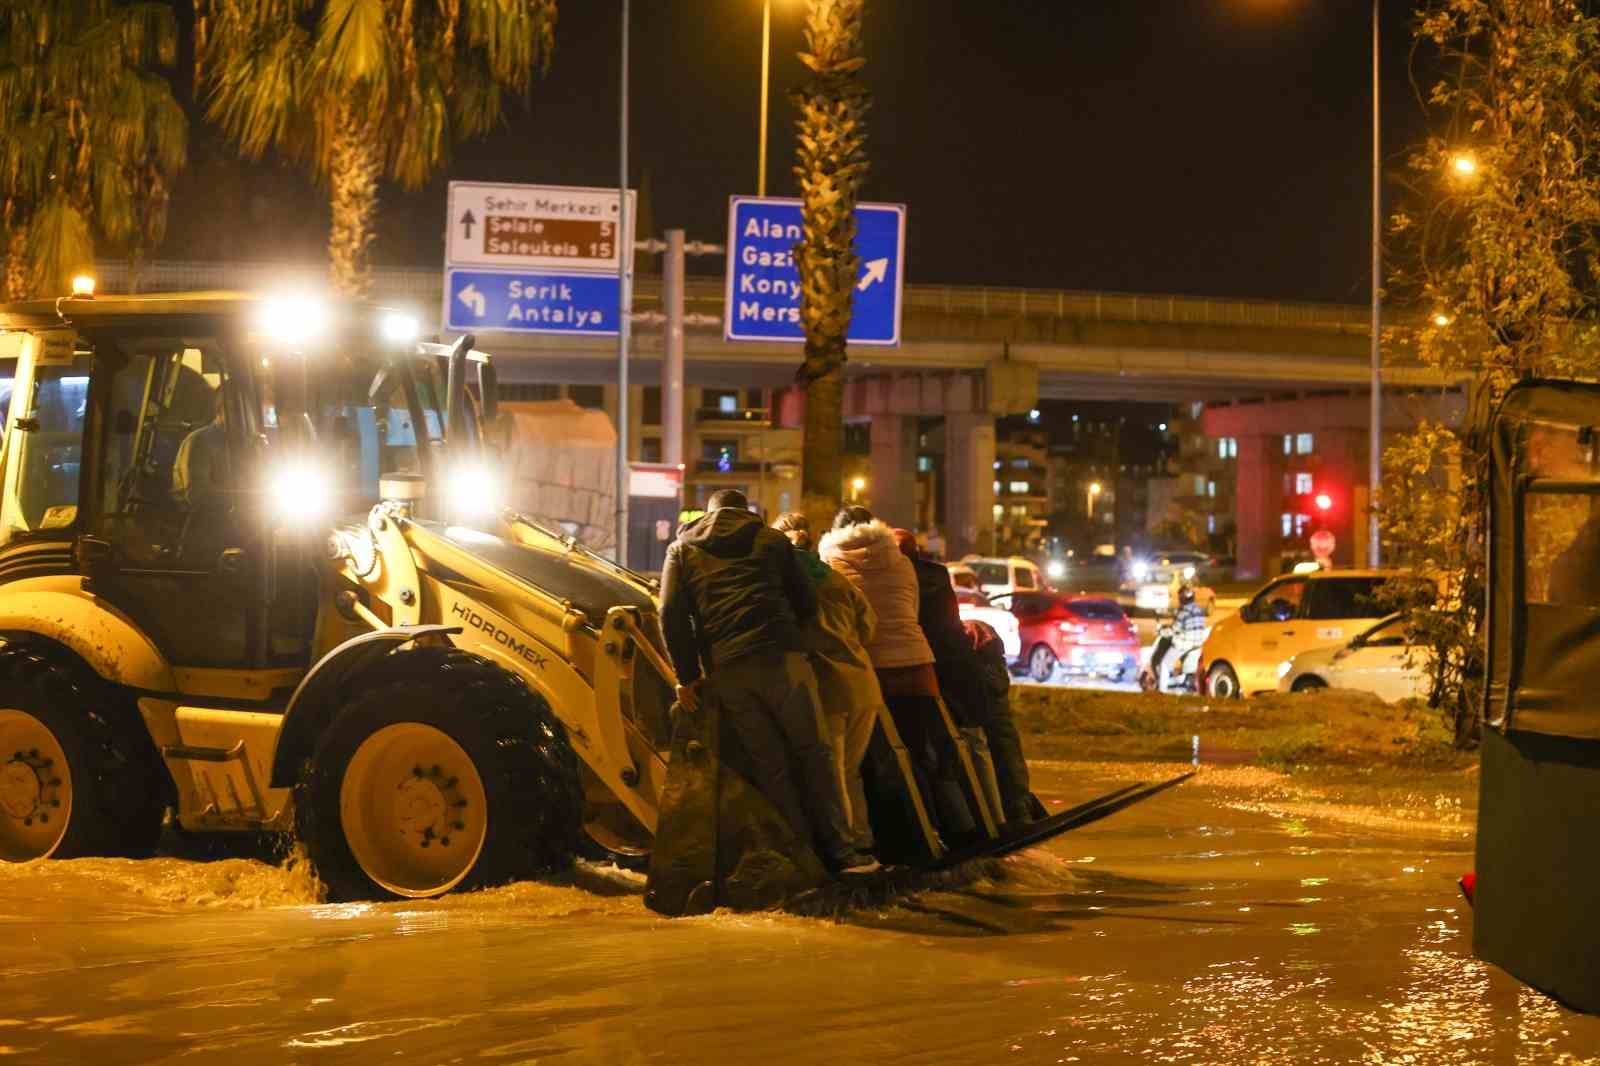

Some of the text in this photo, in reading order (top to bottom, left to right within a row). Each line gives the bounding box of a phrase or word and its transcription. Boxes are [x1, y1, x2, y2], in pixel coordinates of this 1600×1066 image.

[535, 199, 602, 216] Merkezi
[600, 221, 611, 237] 5
[744, 217, 800, 239] Alan
[590, 242, 611, 258] 15
[741, 246, 793, 267] Gazi
[508, 280, 573, 301] Serik
[740, 273, 801, 300] Kony
[507, 303, 603, 328] Antalya
[739, 301, 801, 323] Mers
